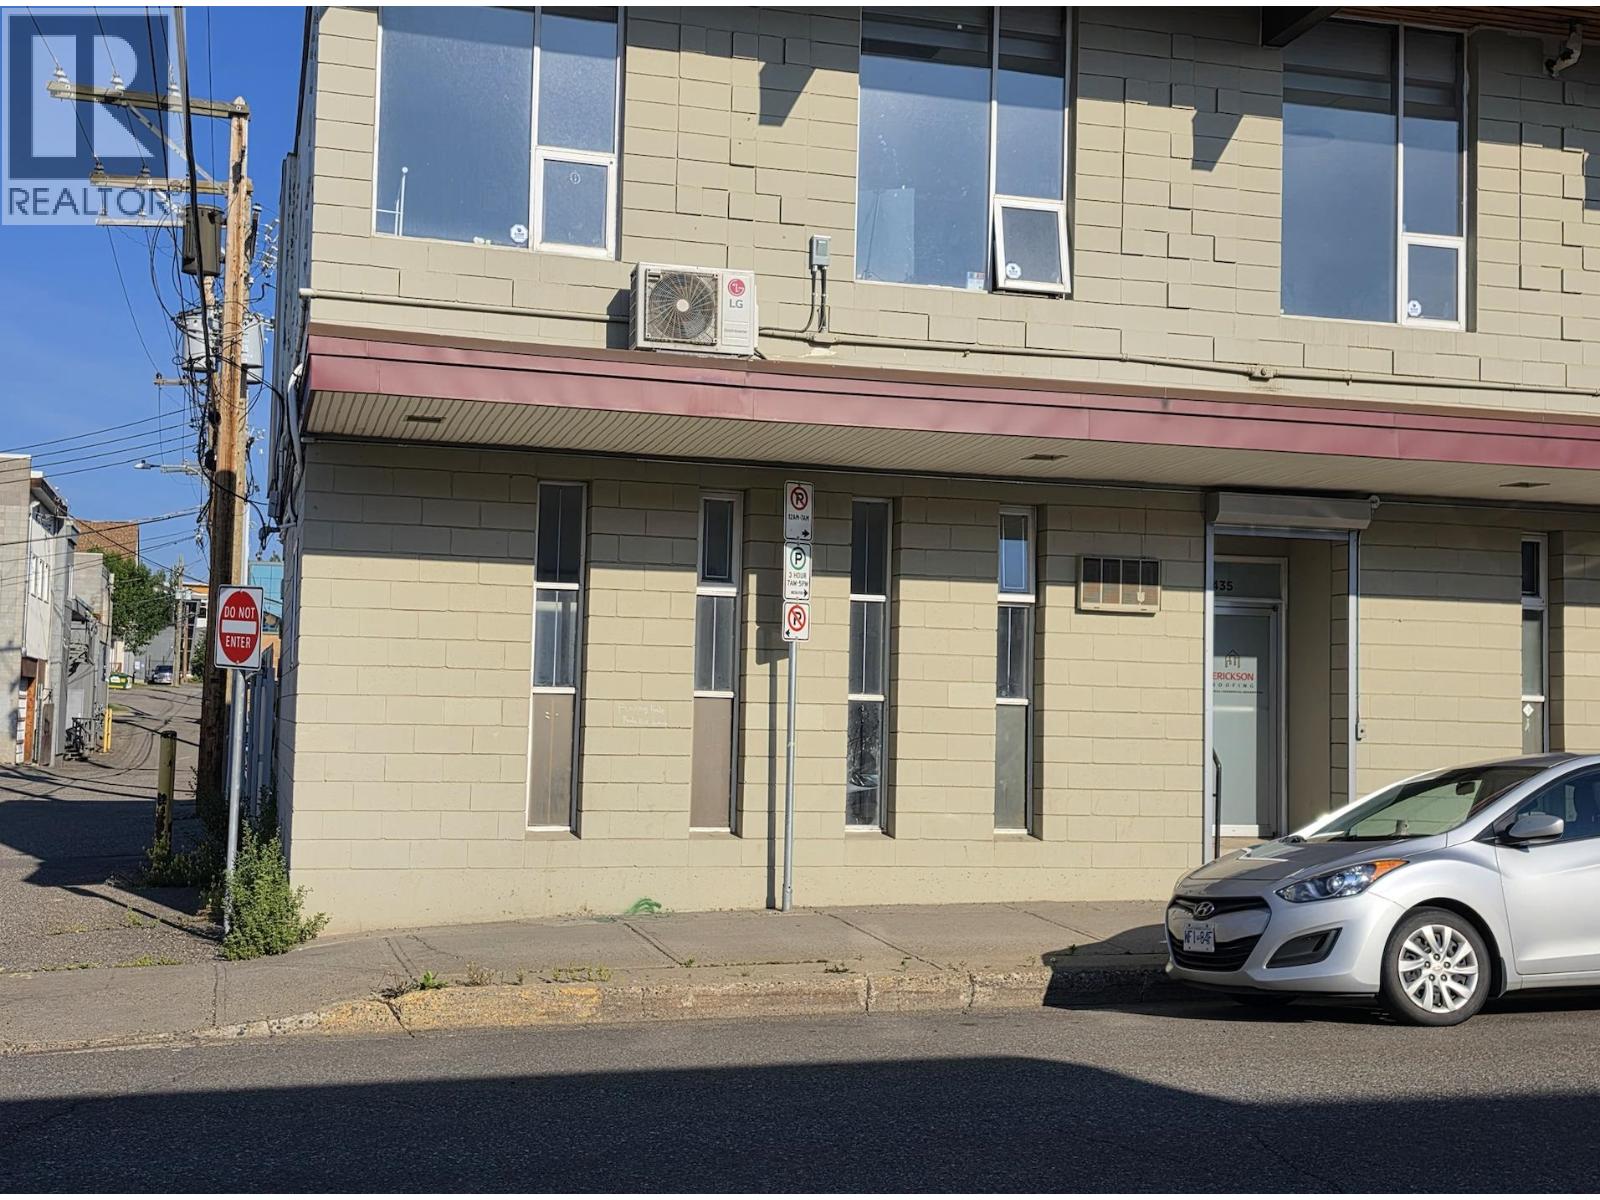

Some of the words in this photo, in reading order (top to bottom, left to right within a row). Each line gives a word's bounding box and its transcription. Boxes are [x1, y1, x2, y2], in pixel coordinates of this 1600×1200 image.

[729, 299, 744, 309] LG
[224, 606, 236, 618] DO
[238, 606, 256, 619] NOT
[225, 635, 251, 649] ENTER
[1213, 671, 1254, 681] ERICKSON
